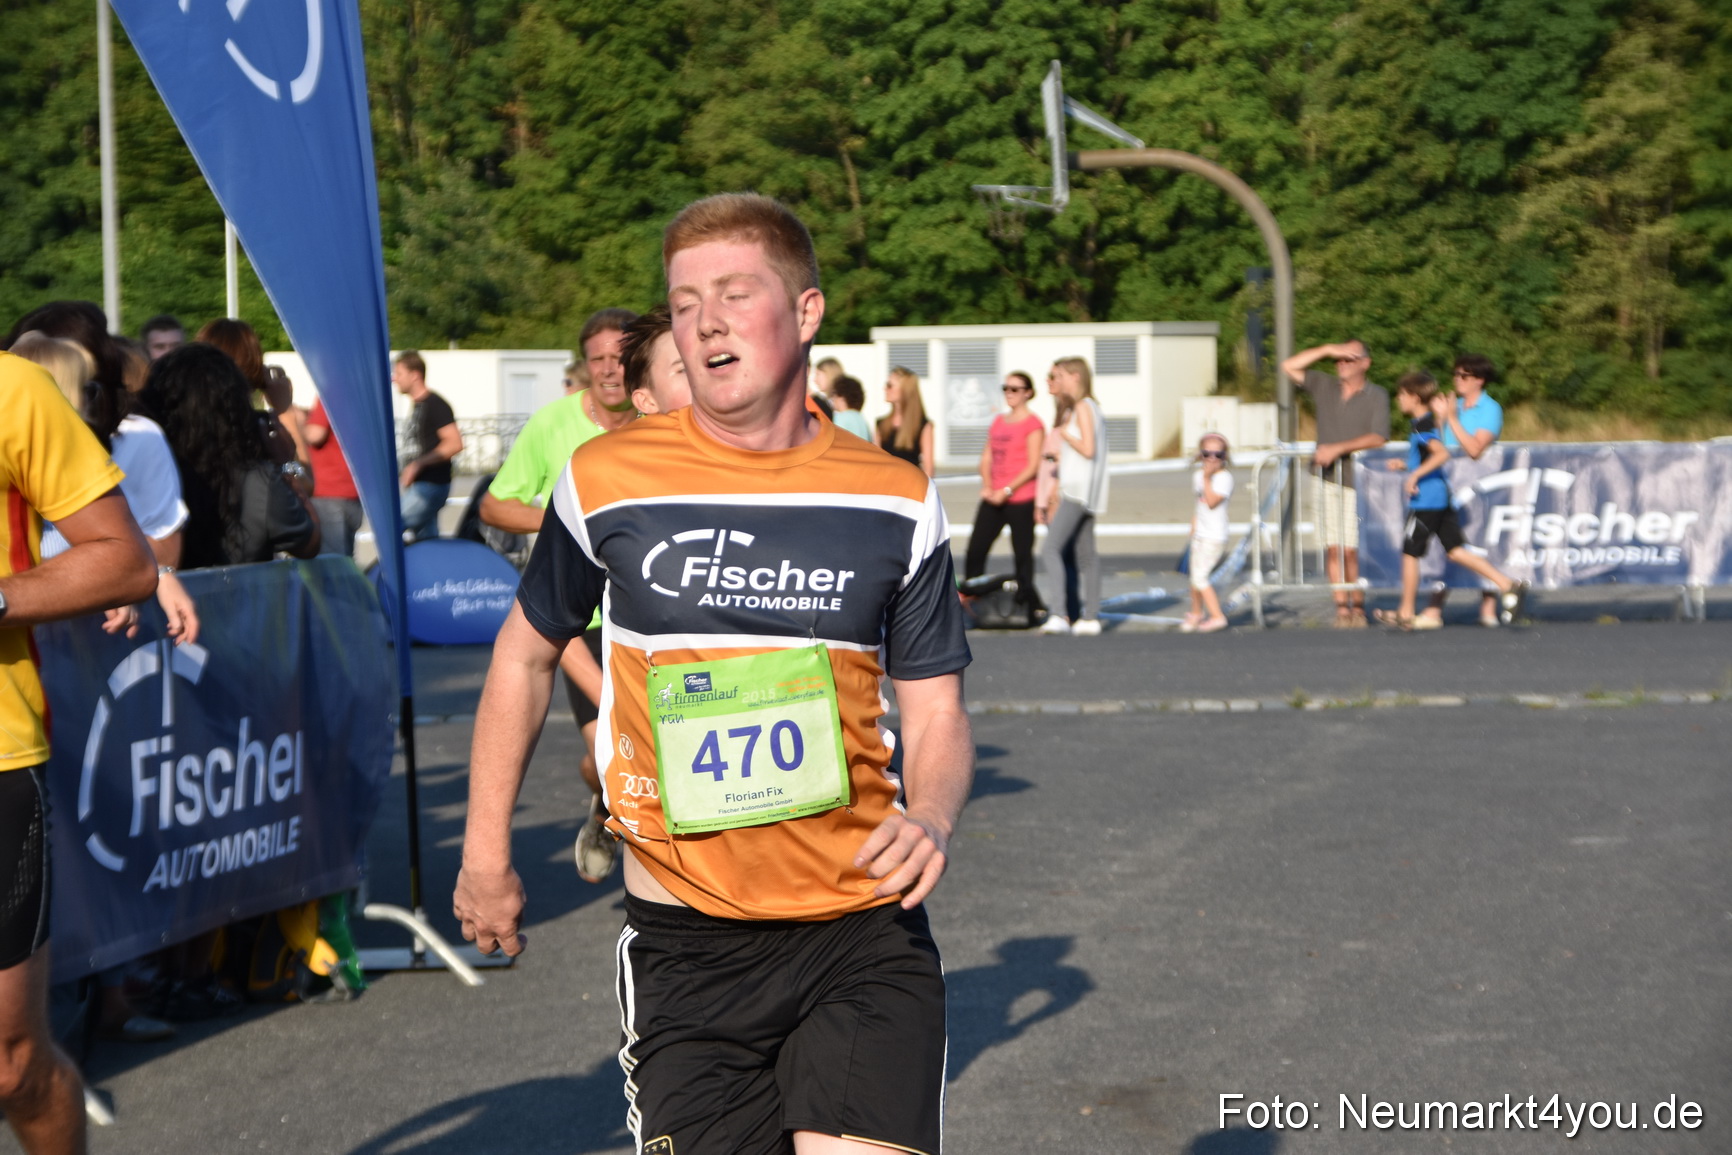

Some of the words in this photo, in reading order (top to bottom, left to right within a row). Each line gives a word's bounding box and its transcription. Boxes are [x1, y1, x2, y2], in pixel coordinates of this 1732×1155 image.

[1485, 502, 1699, 547] Fischer
[1508, 546, 1682, 566] AUTOMOBILE
[680, 556, 855, 592] Fischer
[697, 593, 842, 611] AUTOMOBILE
[674, 686, 739, 704] firmenlauf
[691, 719, 804, 782] 470
[725, 790, 765, 803] Florian
[766, 787, 784, 797] Fix
[718, 806, 740, 814] Fischer
[741, 801, 774, 811] Automobile
[775, 798, 793, 806] GmbH
[142, 815, 302, 893] AUTOMOBILE
